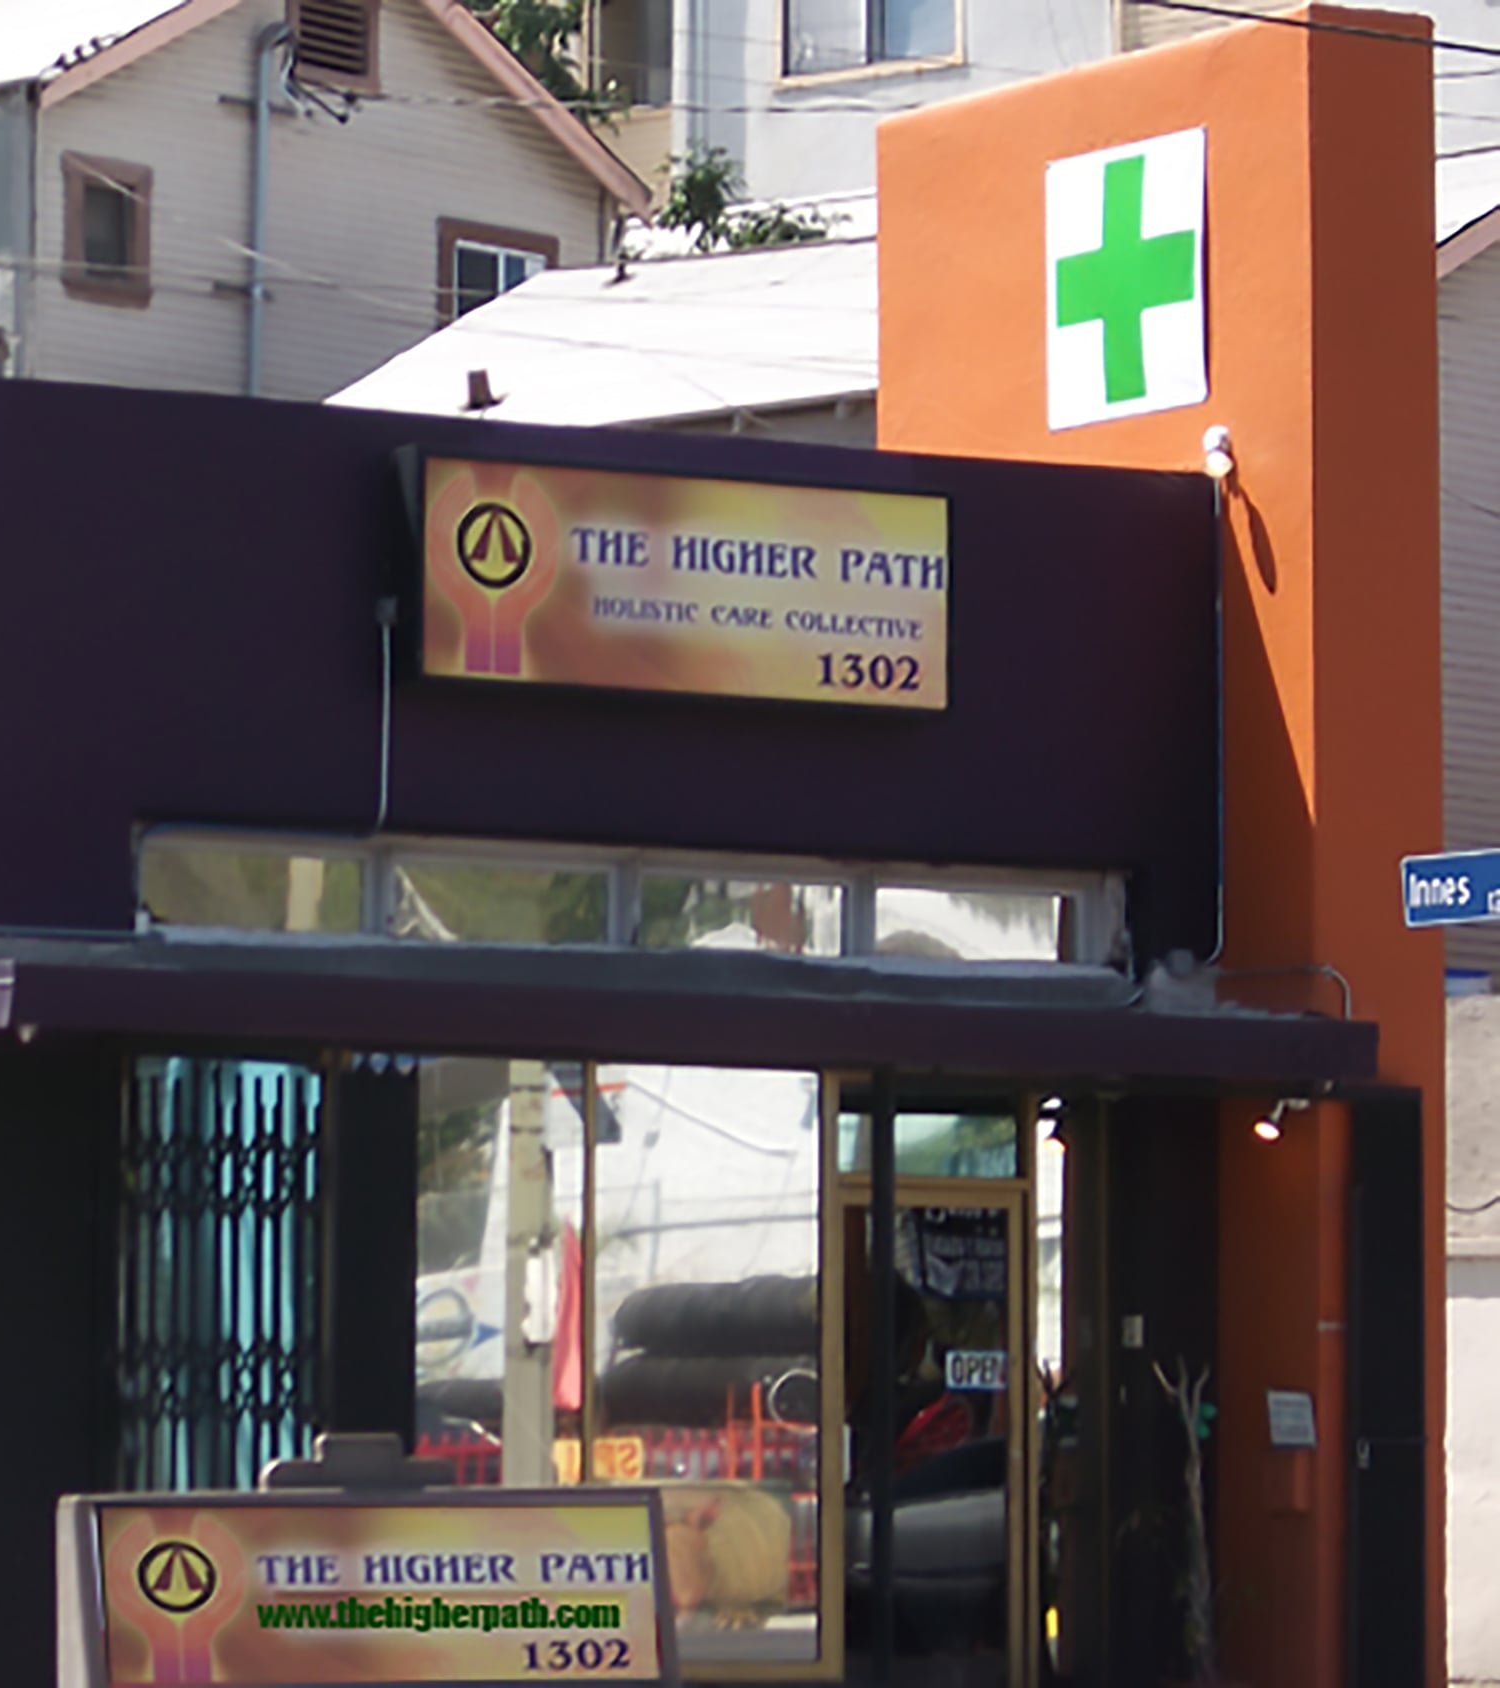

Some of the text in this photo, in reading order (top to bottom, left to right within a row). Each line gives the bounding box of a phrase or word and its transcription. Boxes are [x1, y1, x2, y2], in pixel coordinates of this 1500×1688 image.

[570, 527, 944, 590] THE HIGHER PATH
[594, 597, 922, 640] HOLISTIC CARE COLLECTIVE
[817, 652, 921, 691] 1302
[1409, 873, 1470, 907] Innes
[257, 1553, 650, 1585] THE HIGHER PATH
[257, 1596, 620, 1632] www.thehigherpath.com
[522, 1639, 631, 1670] 1302
